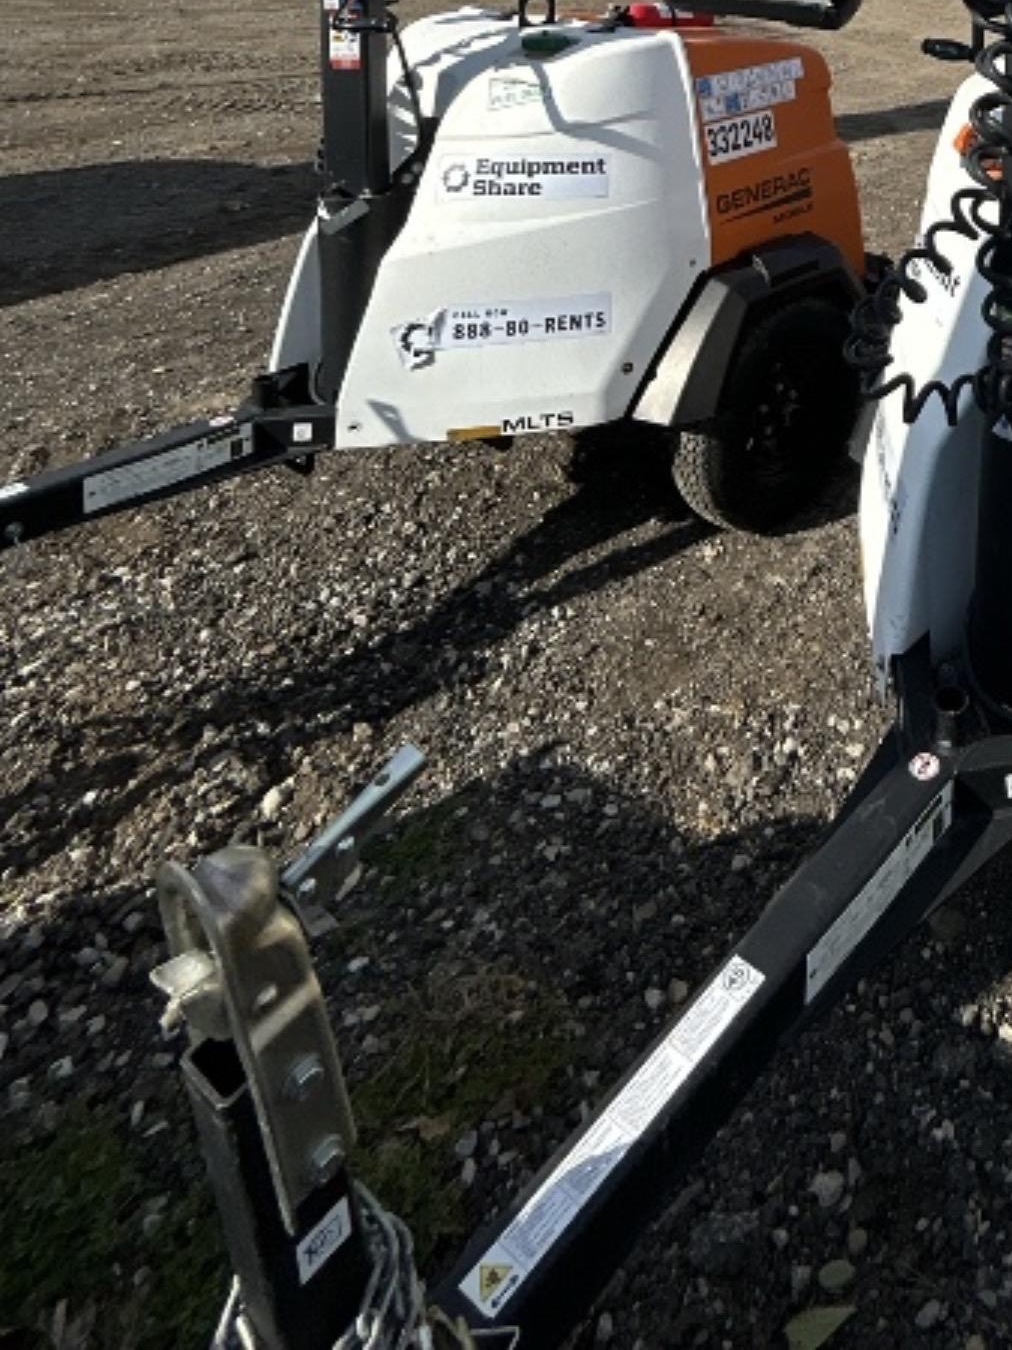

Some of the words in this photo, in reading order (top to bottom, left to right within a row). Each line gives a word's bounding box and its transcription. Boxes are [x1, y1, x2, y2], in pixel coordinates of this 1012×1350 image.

[707, 114, 774, 157] 332248
[476, 158, 606, 178] Equipment
[473, 179, 542, 196] Share
[716, 168, 811, 214] GENERAC
[502, 411, 573, 433] MLTS
